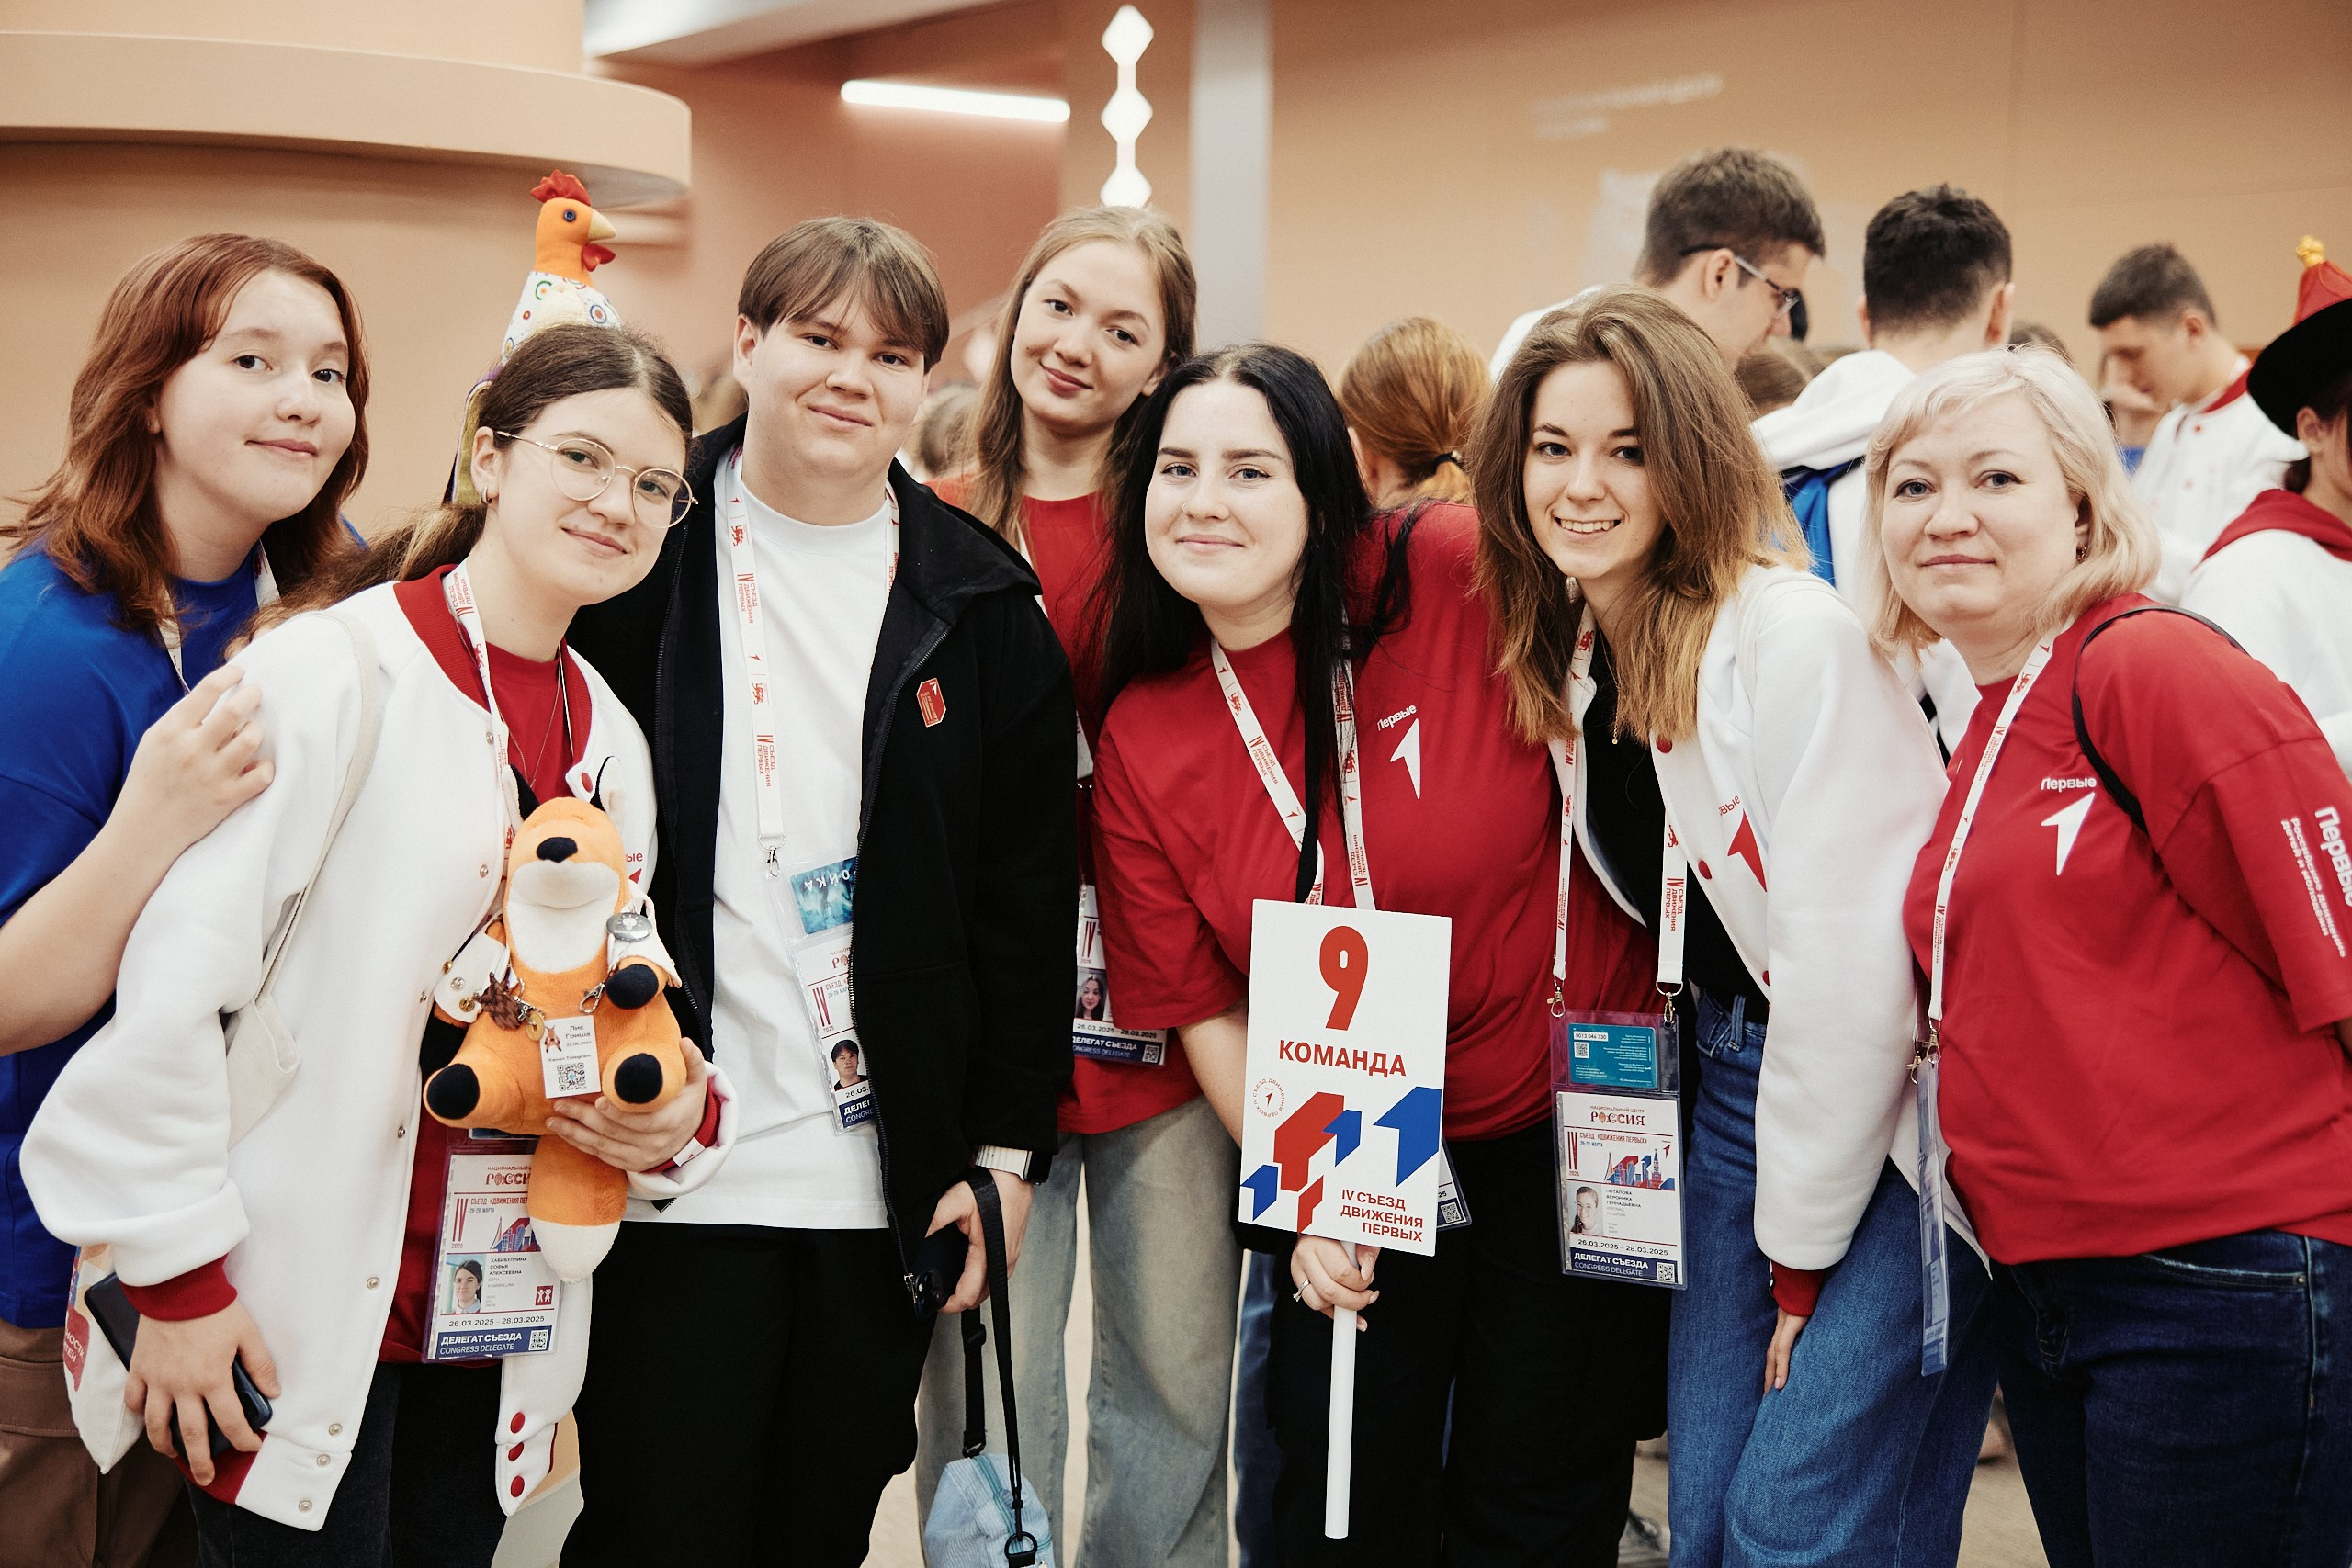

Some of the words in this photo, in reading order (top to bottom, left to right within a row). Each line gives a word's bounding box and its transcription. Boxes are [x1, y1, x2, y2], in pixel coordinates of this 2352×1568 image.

[744, 584, 753, 623] ДВИЖЕНИЯ
[1377, 705, 1417, 731] Первые
[757, 735, 773, 743] IV
[1249, 735, 1264, 748] IV
[1253, 749, 1267, 776] ПЕРВЫХ
[1262, 744, 1275, 767] СЪЕЗД
[1257, 748, 1278, 784] ДВИЖЕНИЯ
[2041, 777, 2097, 793] Первые
[1719, 795, 1740, 817] вые
[804, 869, 856, 891] ОЙКА
[1667, 878, 1684, 887] IV
[1319, 926, 1368, 1031] 9
[813, 987, 830, 1027] IV
[1077, 1024, 1114, 1033] 26.03.2025
[1073, 1046, 1100, 1054] ONGRESS
[1106, 1041, 1137, 1050] СЪЕЗДА
[1279, 1039, 1406, 1078] КОМАНДА
[846, 1086, 869, 1098] 26.03.
[844, 1099, 871, 1116] ДЕЛЕГ
[846, 1108, 873, 1123] CONGRE
[1590, 1111, 1645, 1126] РОССИЯ
[1568, 1131, 1577, 1170] IV
[485, 1173, 531, 1186] РОССИ
[1342, 1189, 1354, 1201] IV
[1356, 1191, 1405, 1211] СЪЕЗД
[452, 1198, 468, 1242] IV
[1340, 1204, 1423, 1228] ДВИЖЕНИЯ
[1363, 1221, 1423, 1243] ПЕРВЫХ
[1578, 1239, 1619, 1250] 26.03.2025
[1626, 1246, 1668, 1256] 28.03.2025
[1574, 1253, 1612, 1263] ДЕЛЕГАТ
[1612, 1258, 1649, 1269] СЪЕЗДА
[1574, 1262, 1610, 1272] CONGRESS
[1611, 1268, 1643, 1277] DELEGATE
[449, 1319, 494, 1327] 26.03.2025
[502, 1316, 545, 1324] 28.03.2025
[441, 1335, 483, 1346] ДЕЛЕГАТ
[484, 1333, 522, 1342] СЪЕЗДА
[440, 1345, 479, 1355] CONGRESS
[480, 1343, 514, 1352] DELEGATE
